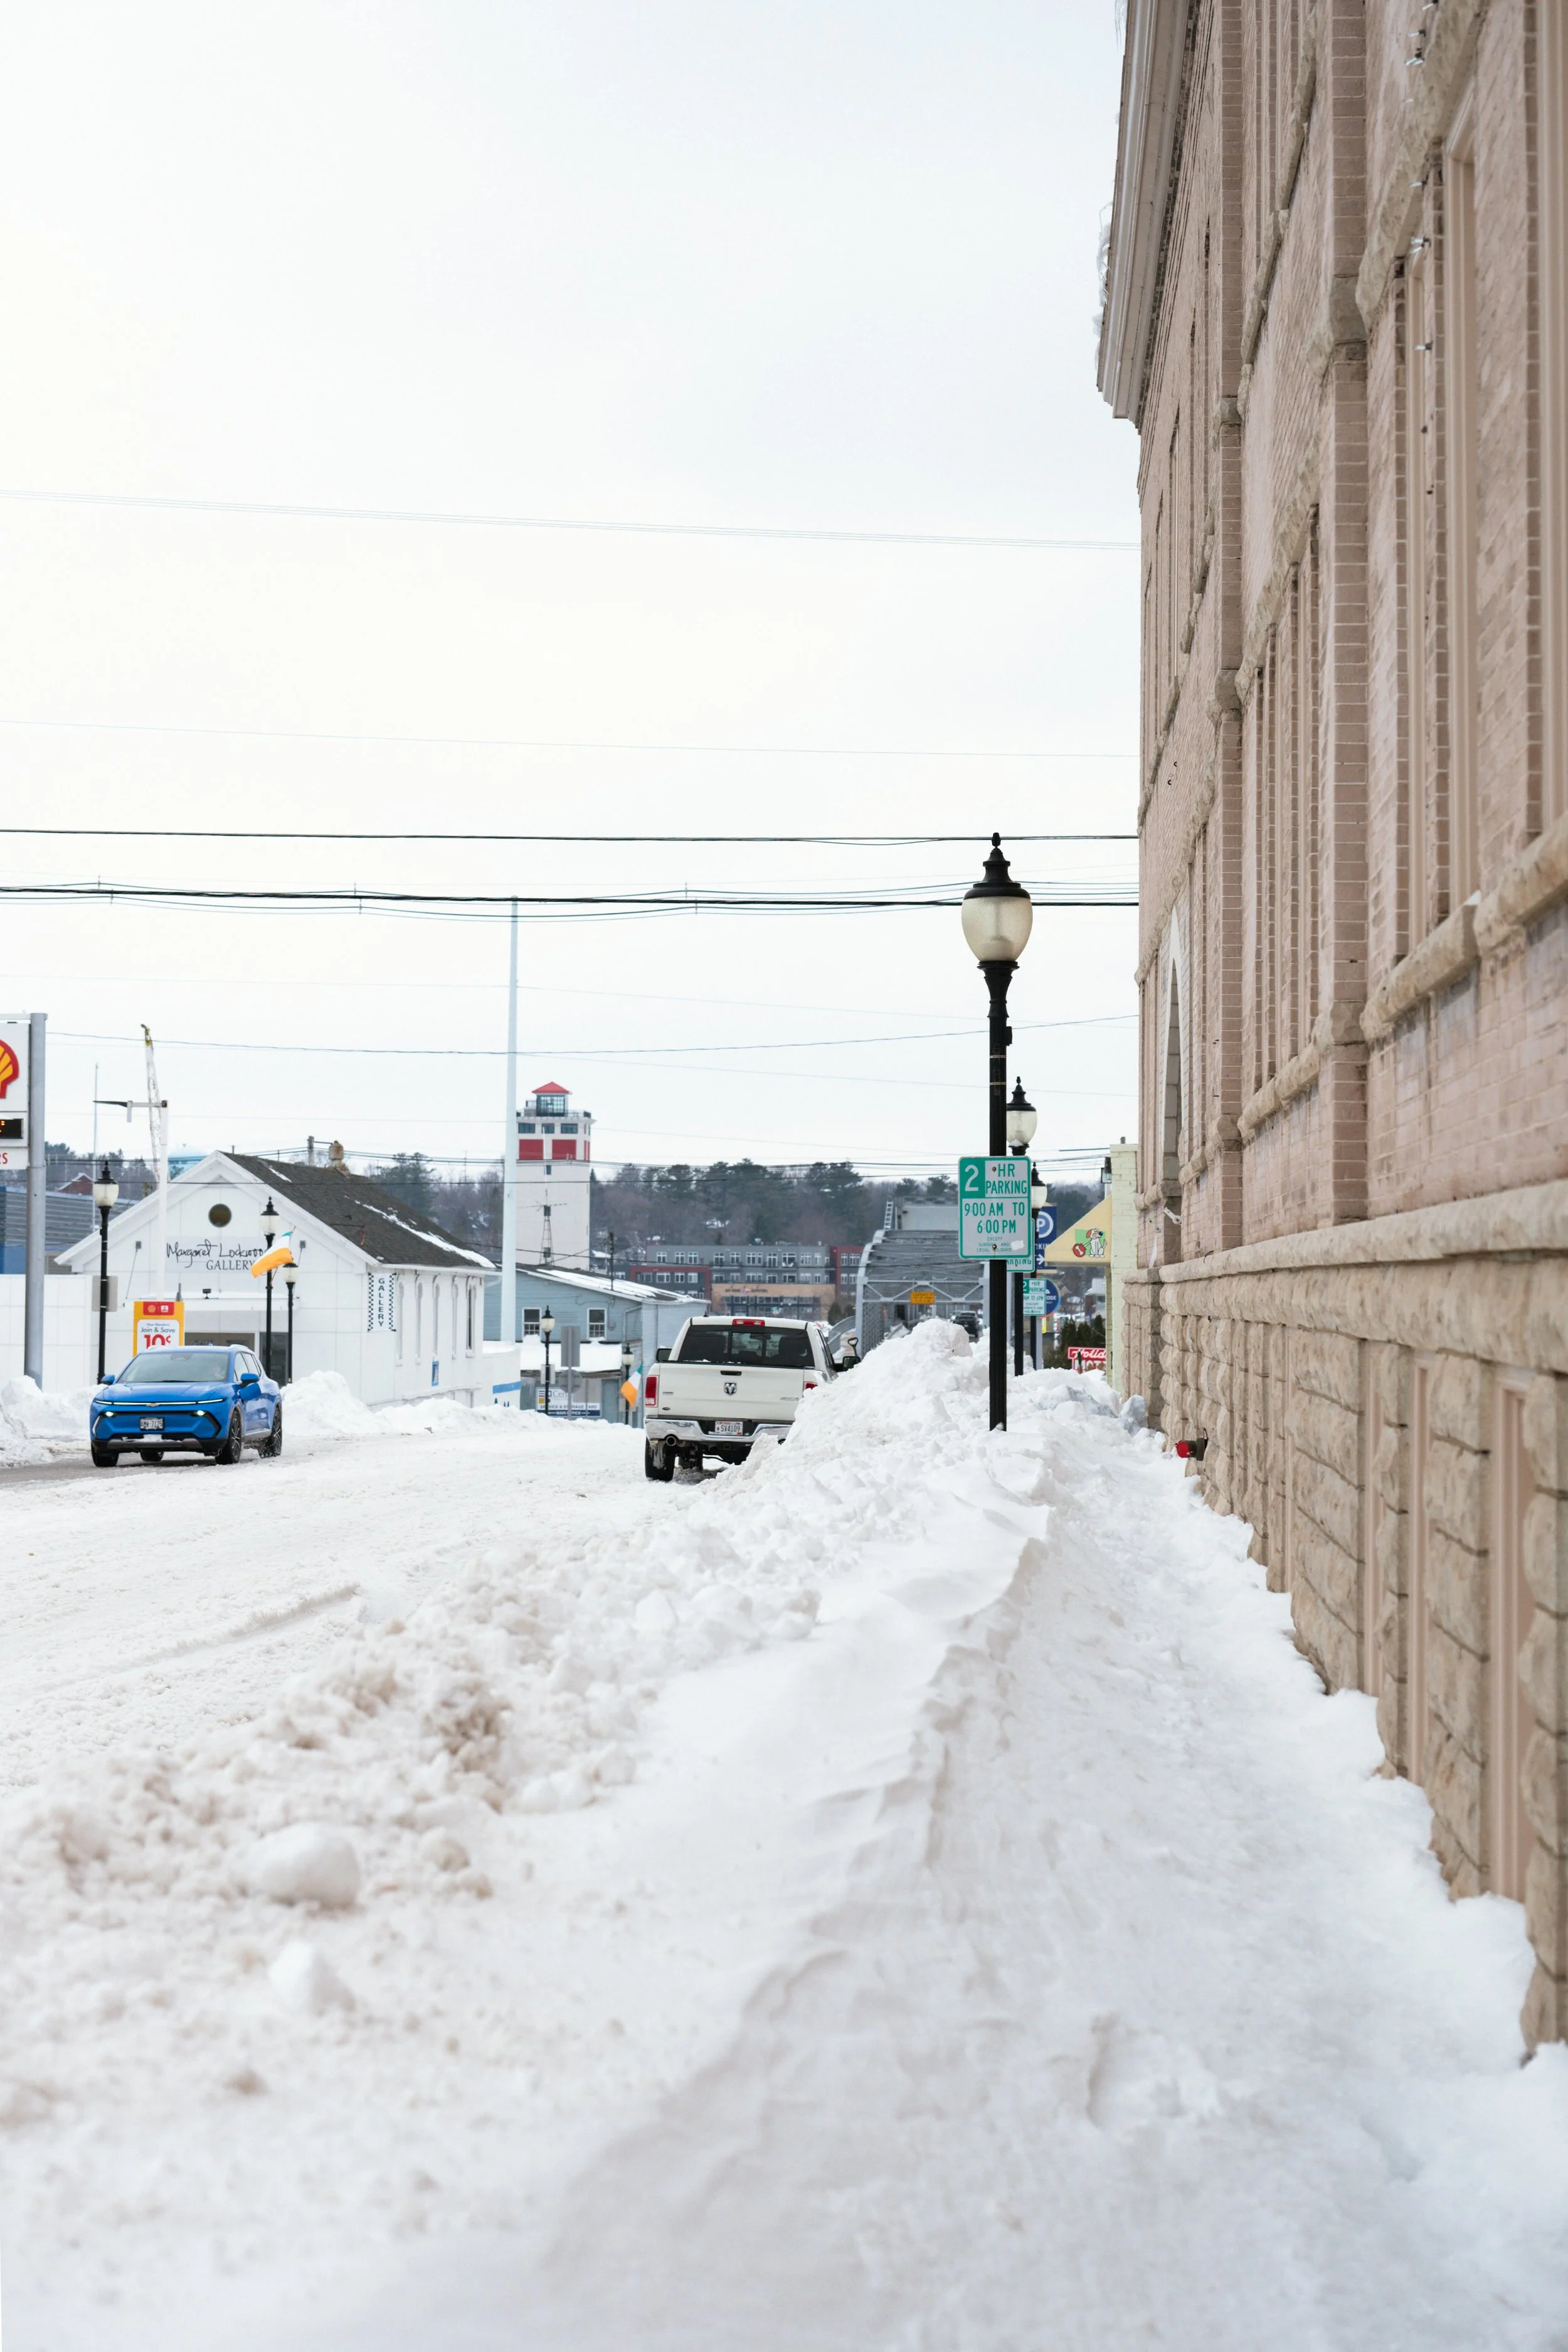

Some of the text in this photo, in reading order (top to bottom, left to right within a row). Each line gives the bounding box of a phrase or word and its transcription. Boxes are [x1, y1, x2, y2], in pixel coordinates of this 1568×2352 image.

[964, 1163, 1015, 1191] 2 HR
[985, 1180, 1027, 1195] PARKING
[988, 1202, 1004, 1217] AM
[1012, 1202, 1025, 1216] TO
[1002, 1219, 1017, 1233] PM
[166, 1239, 268, 1268] Margaret Lockwoo
[721, 1424, 741, 1433] SV4109
